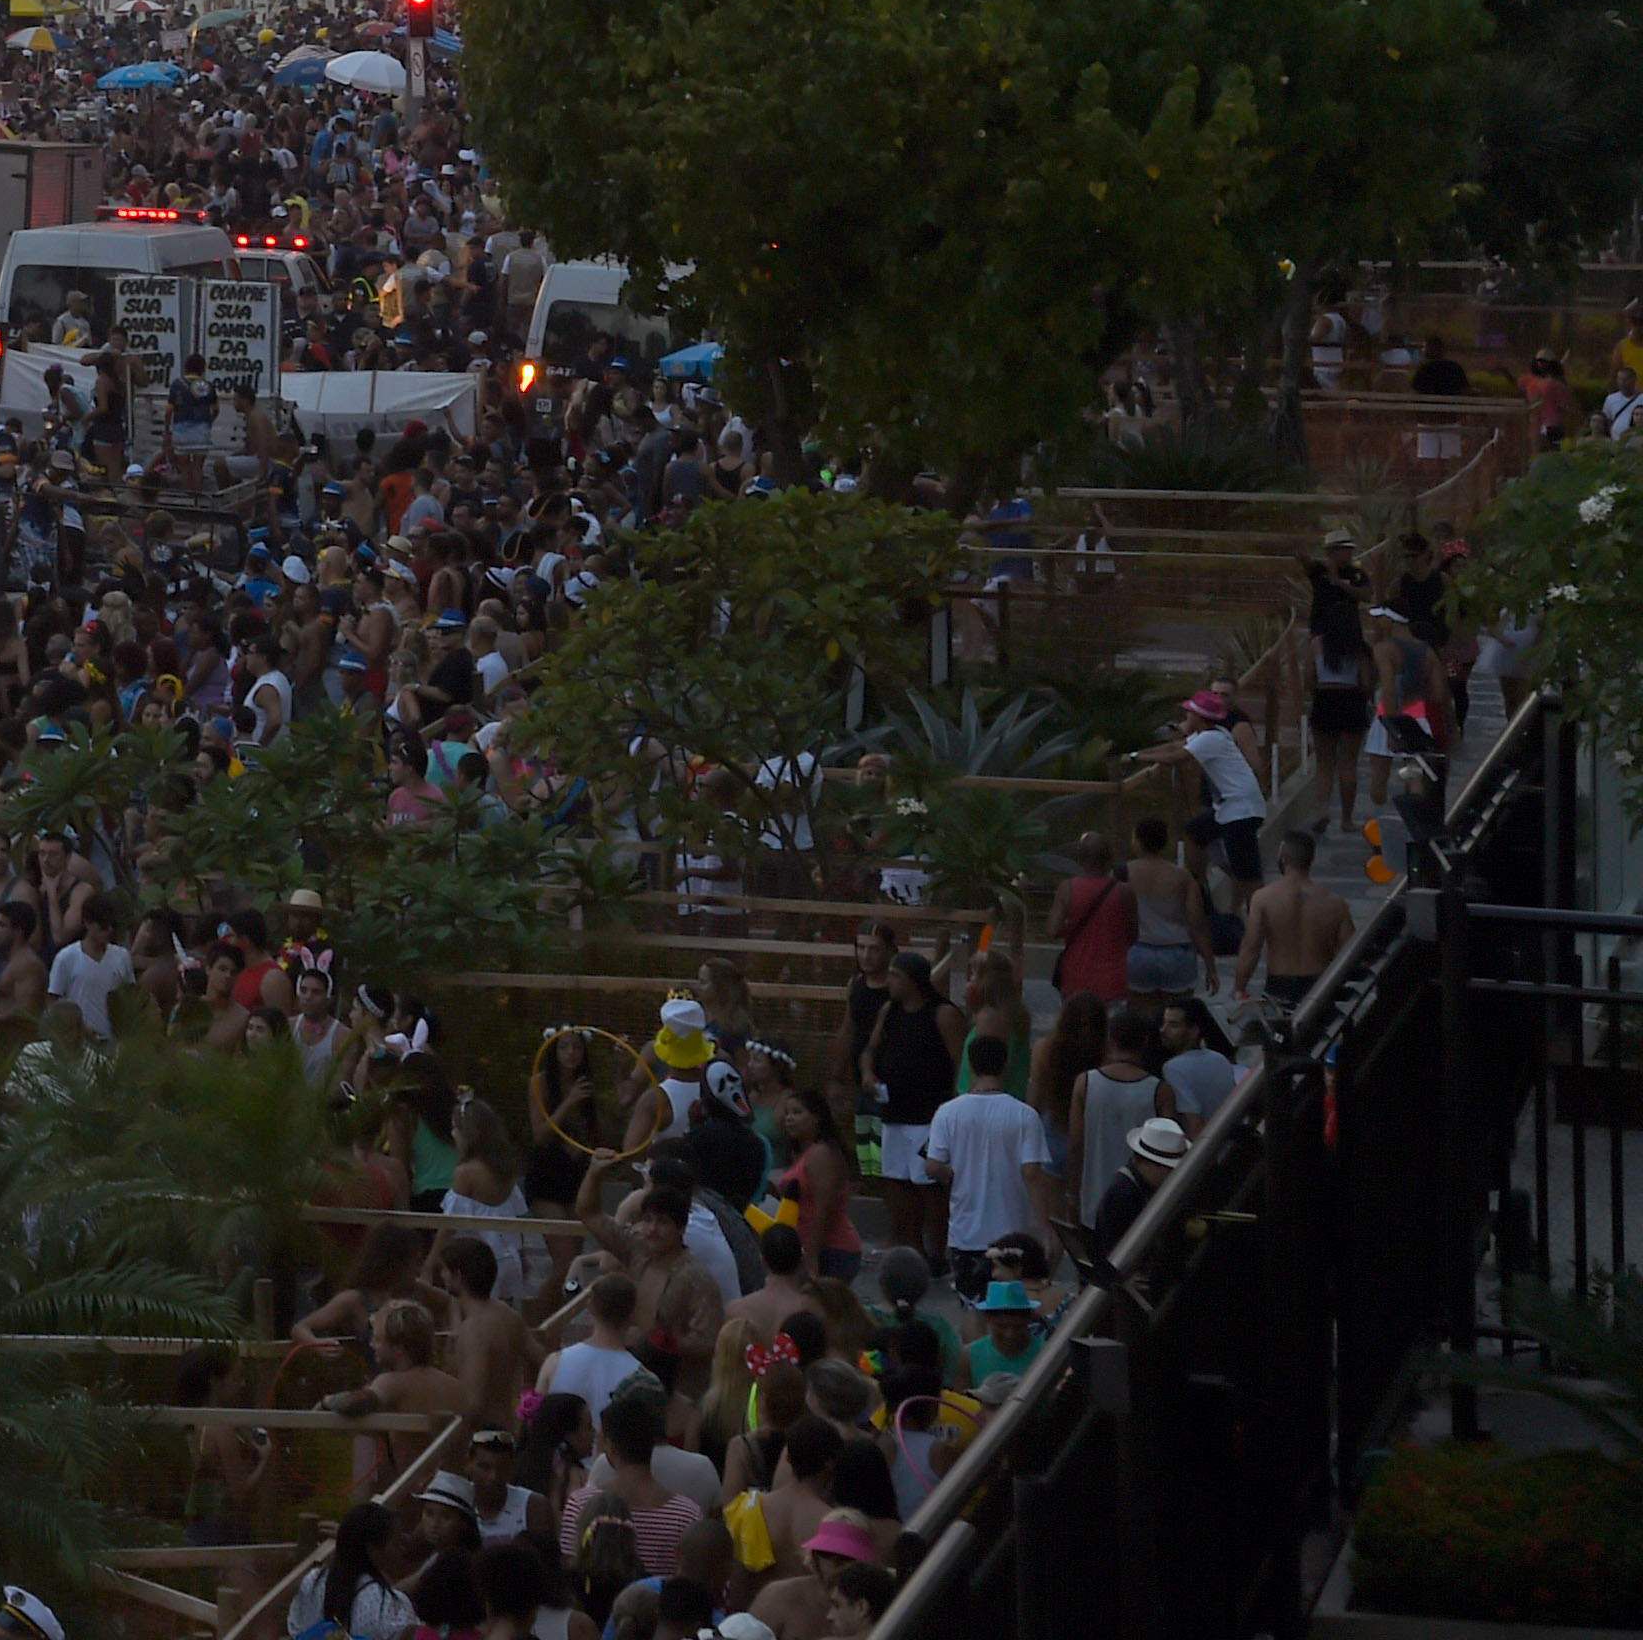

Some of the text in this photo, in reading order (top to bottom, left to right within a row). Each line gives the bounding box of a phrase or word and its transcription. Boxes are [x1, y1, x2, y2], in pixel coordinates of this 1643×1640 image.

[119, 279, 176, 296] COMPRE
[210, 285, 267, 302] COMPRE
[123, 298, 162, 314] SUA
[214, 304, 252, 320] SUA
[121, 317, 175, 334] CAMISA
[208, 323, 265, 340] CAMISA
[130, 334, 159, 349] DA
[218, 341, 248, 356] DA
[208, 357, 263, 373] BANDA
